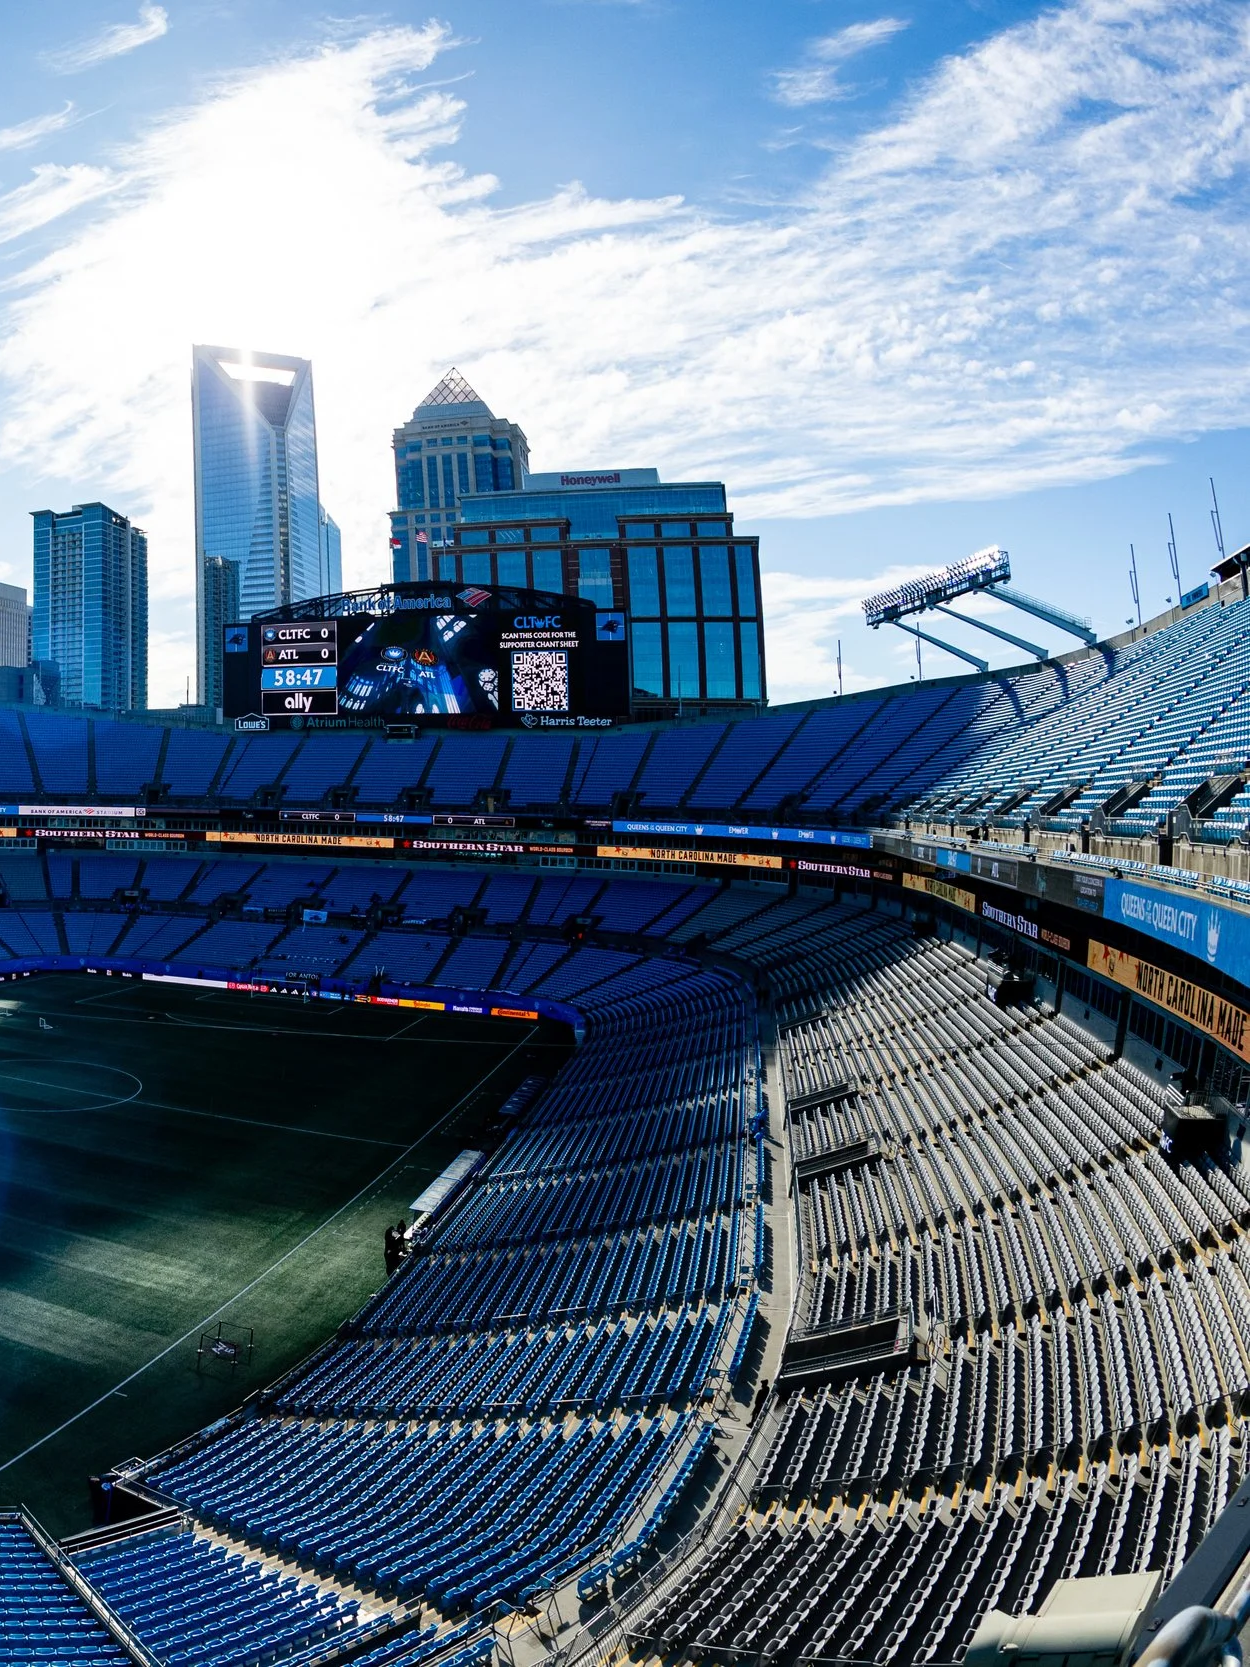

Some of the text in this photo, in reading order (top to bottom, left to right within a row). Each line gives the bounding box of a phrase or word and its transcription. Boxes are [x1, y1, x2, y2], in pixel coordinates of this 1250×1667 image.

[560, 473, 621, 486] Honeywell
[342, 598, 376, 612] Bank
[394, 594, 452, 610] America
[278, 628, 329, 640] CLTFC 0
[499, 641, 535, 649] SUPPORTER
[278, 649, 299, 660] ATL
[321, 648, 329, 659] 0
[376, 664, 405, 673] CLTFC
[274, 669, 323, 686] 58:47
[419, 671, 436, 679] ATL
[284, 692, 313, 712] ally
[306, 716, 385, 728] Atrium Health
[540, 716, 612, 726] Harris Teeter
[334, 813, 340, 821] 0
[383, 814, 405, 822] 58:47
[35, 829, 140, 838] SOUTHERN STAR
[255, 833, 343, 845] NORTH CAROLINA MADE
[412, 840, 524, 853] SOUTHERN STAR
[651, 849, 737, 863] NORTH CAROLINA MADE
[798, 860, 848, 875] SOUTHERN
[848, 865, 871, 878] STAR
[982, 901, 1039, 939] SOUTHERN STAR
[1121, 893, 1146, 921] QUEENS
[1152, 902, 1178, 934] QUEEN
[1178, 911, 1198, 941] CITY
[1136, 961, 1247, 1051] NORTH CAROLINA MADE
